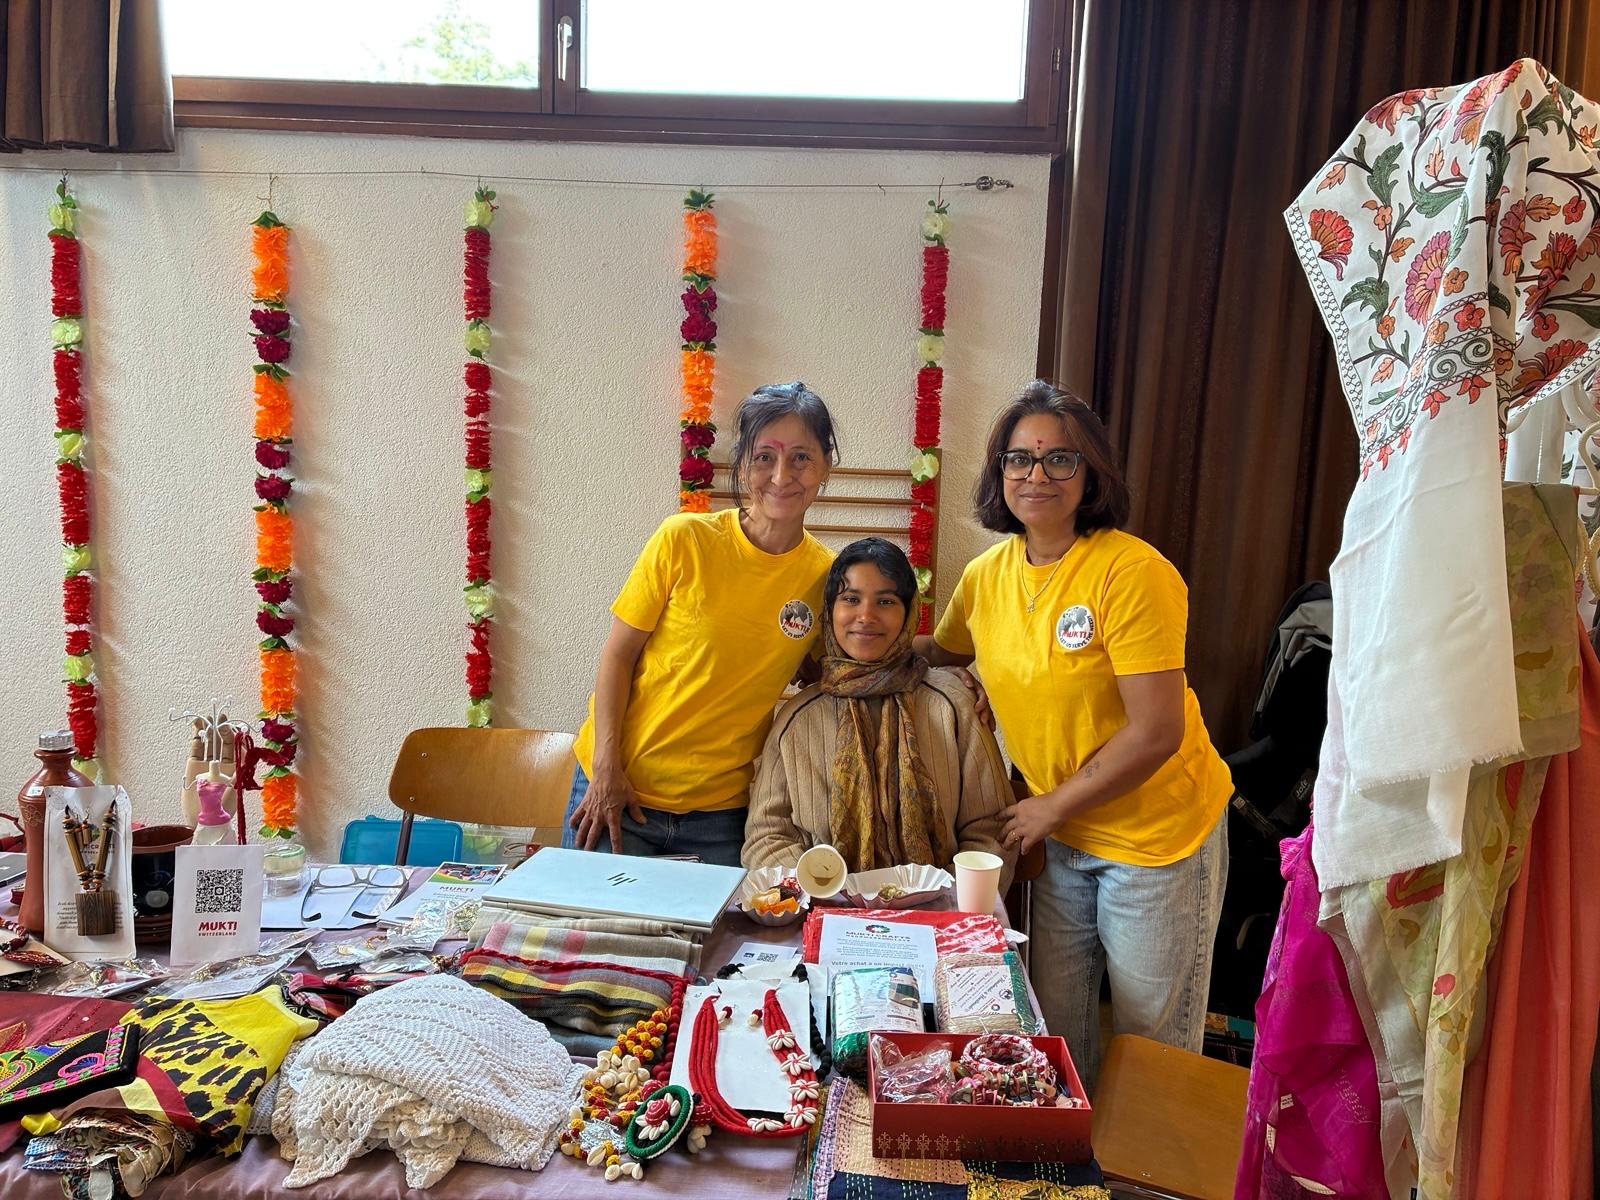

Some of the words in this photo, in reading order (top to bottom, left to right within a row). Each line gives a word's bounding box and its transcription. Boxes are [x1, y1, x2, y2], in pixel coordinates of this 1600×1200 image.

[784, 620, 807, 632] MUKTI
[1062, 630, 1088, 639] MUKTI
[1071, 640, 1088, 649] SERVE
[198, 921, 237, 931] MUKTI
